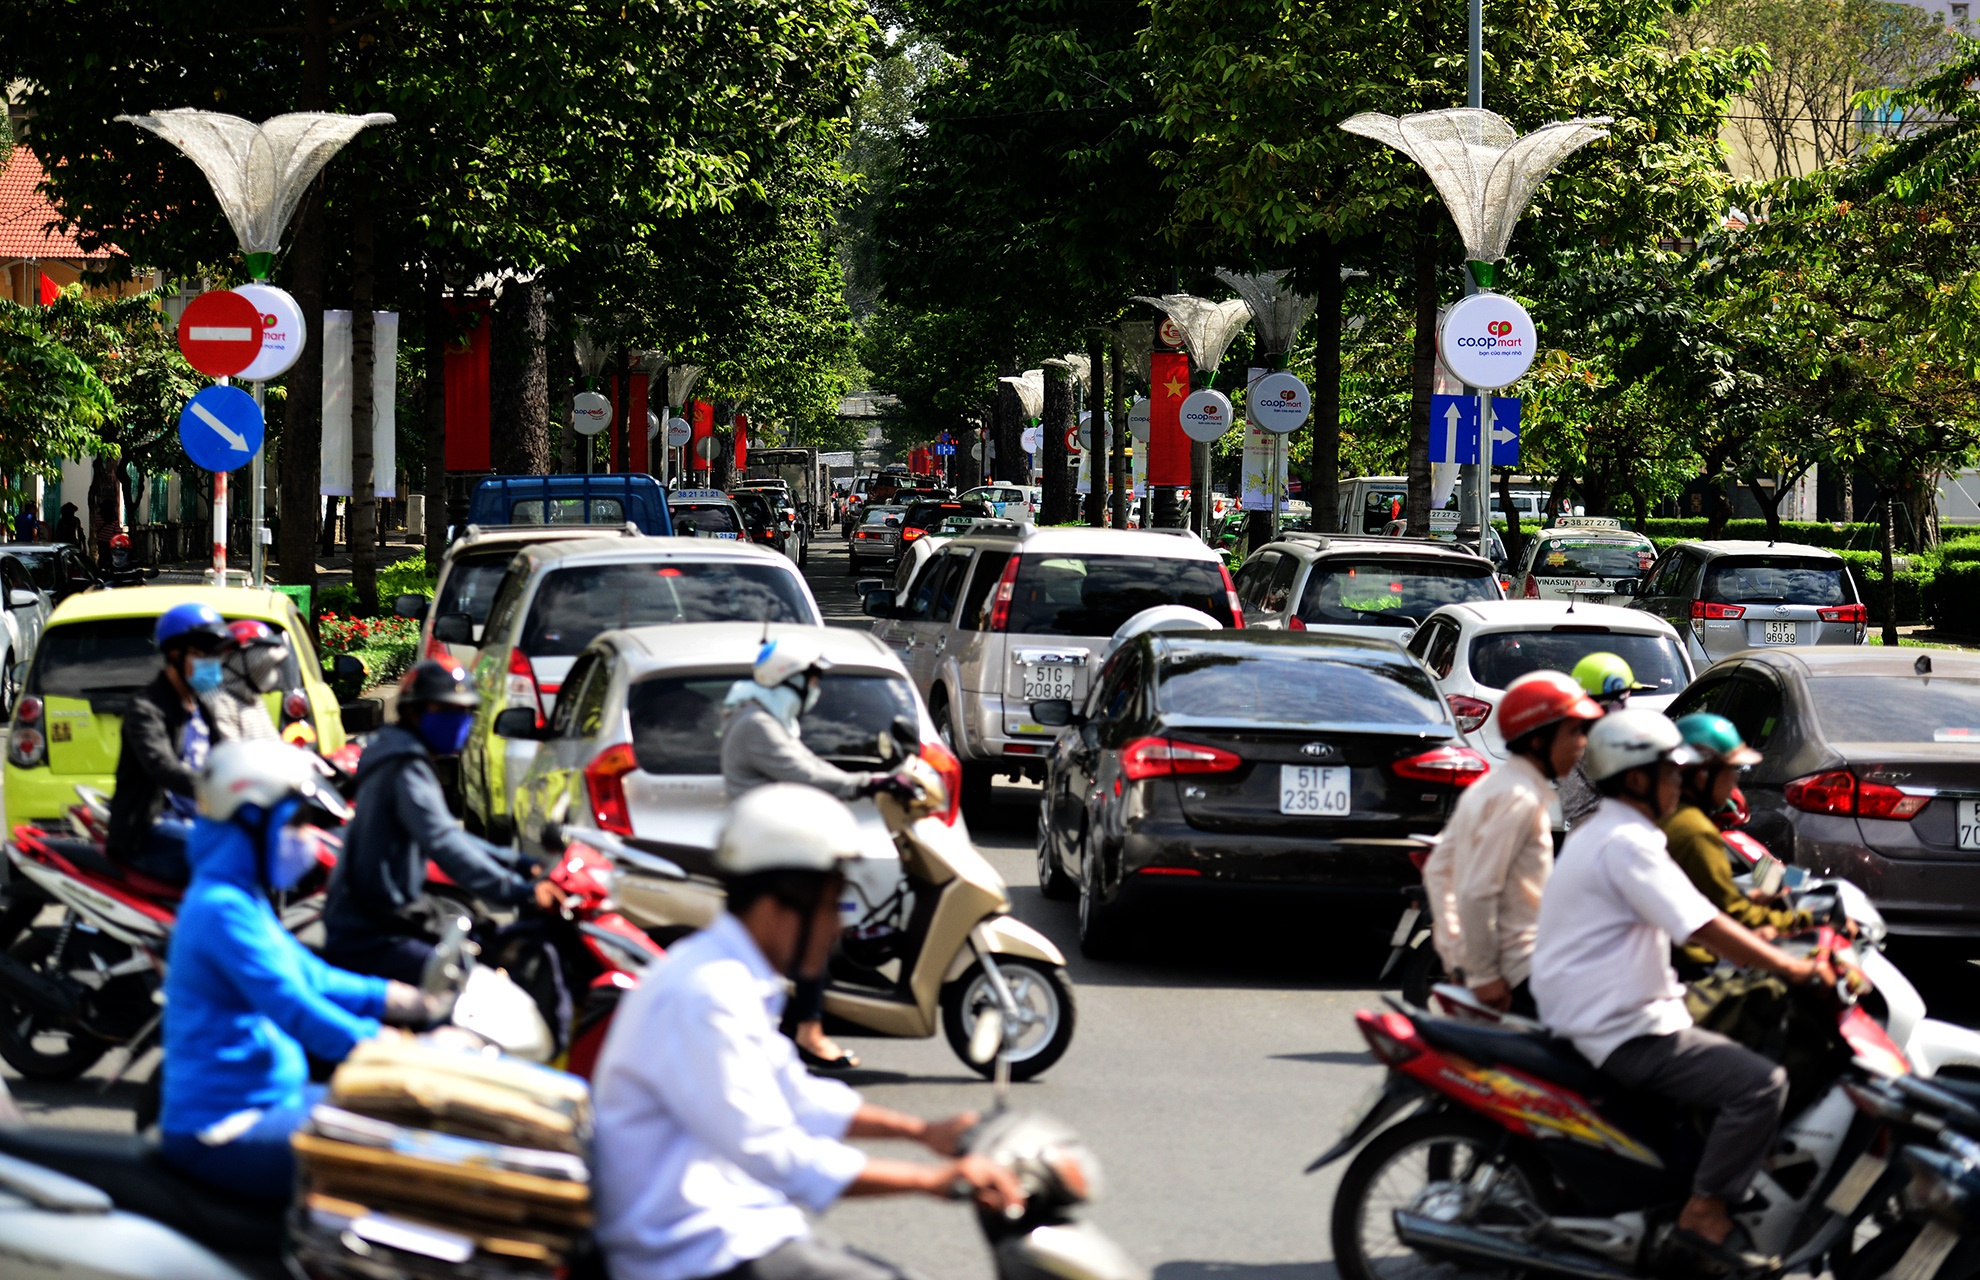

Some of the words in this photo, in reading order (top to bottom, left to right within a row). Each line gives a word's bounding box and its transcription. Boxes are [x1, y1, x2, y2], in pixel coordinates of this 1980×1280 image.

[1772, 623, 1788, 632] 51F
[1766, 632, 1796, 643] 969.39
[1036, 667, 1062, 682] 51G
[1026, 682, 1071, 700] 208.82
[1306, 745, 1330, 756] KIA
[1298, 769, 1334, 789] 51F
[1284, 790, 1347, 811] 235.40
